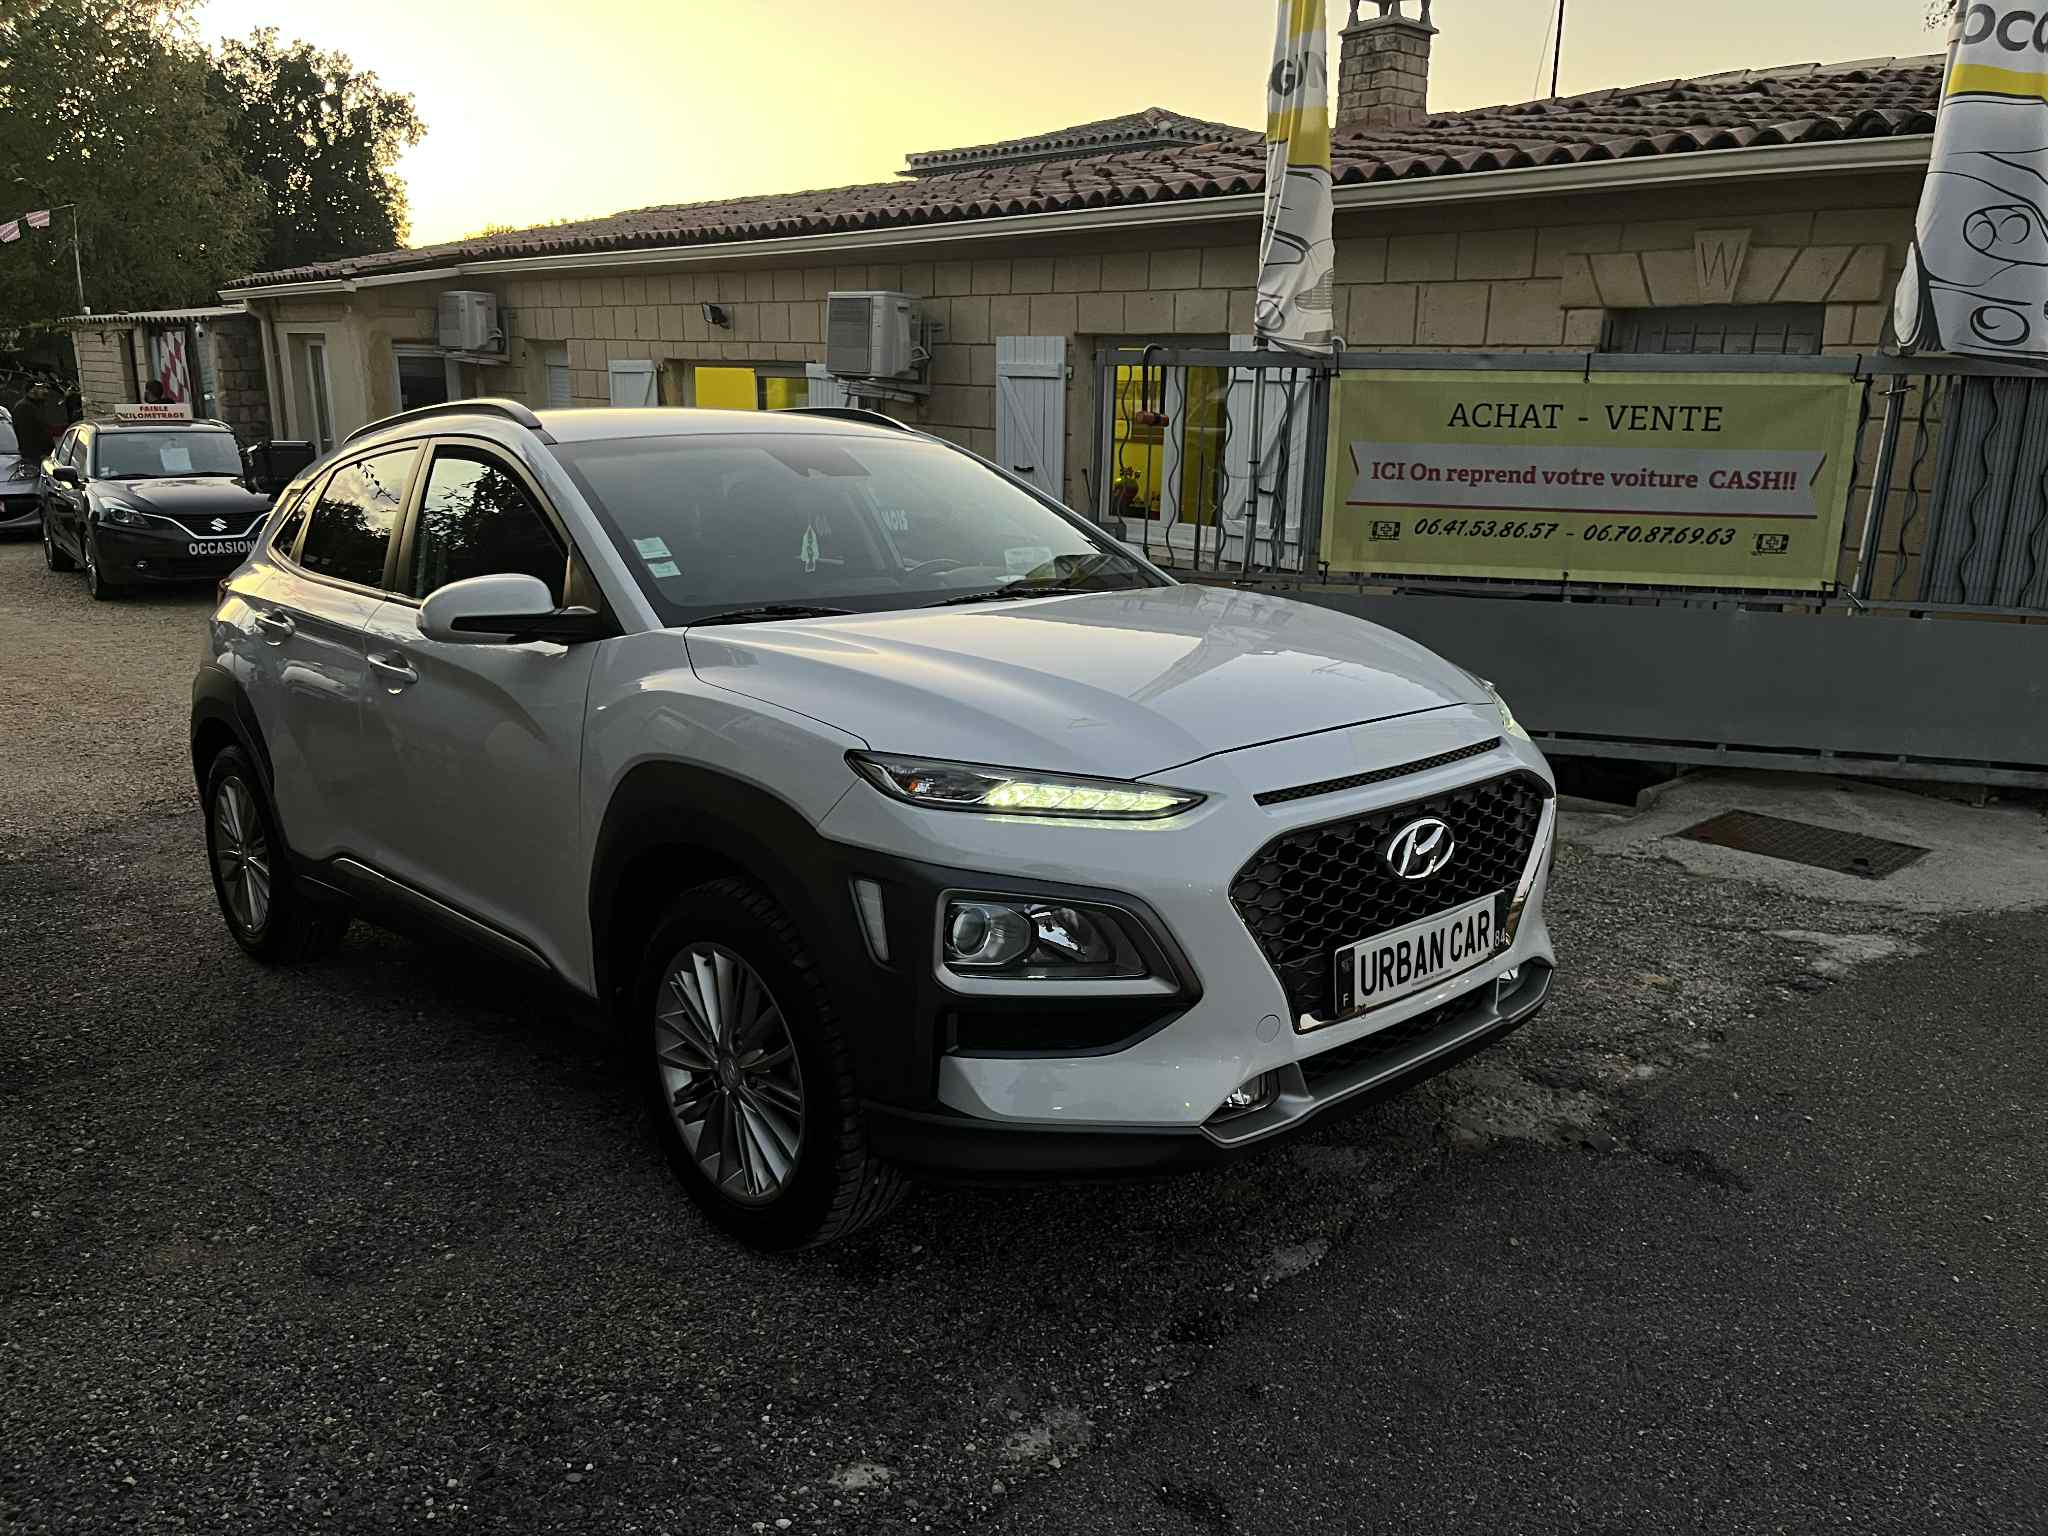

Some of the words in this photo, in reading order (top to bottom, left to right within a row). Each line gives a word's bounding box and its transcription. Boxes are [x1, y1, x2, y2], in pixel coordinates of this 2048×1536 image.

[1448, 402, 1564, 429] ACHAT
[1605, 404, 1723, 432] VENTE
[1371, 462, 1405, 480] ICI
[1410, 463, 1440, 481] On
[1446, 466, 1537, 486] reprend
[1542, 468, 1605, 486] votre
[1610, 468, 1698, 488] voiture
[1709, 470, 1797, 491] CASH!!
[1414, 518, 1560, 540] 06.41.53.86.57
[1583, 524, 1736, 546] 06.70.87.69.63
[188, 540, 256, 556] OCCASION
[1360, 928, 1446, 997] URBAN
[1450, 910, 1491, 963] CAR
[1342, 992, 1350, 1007] F
